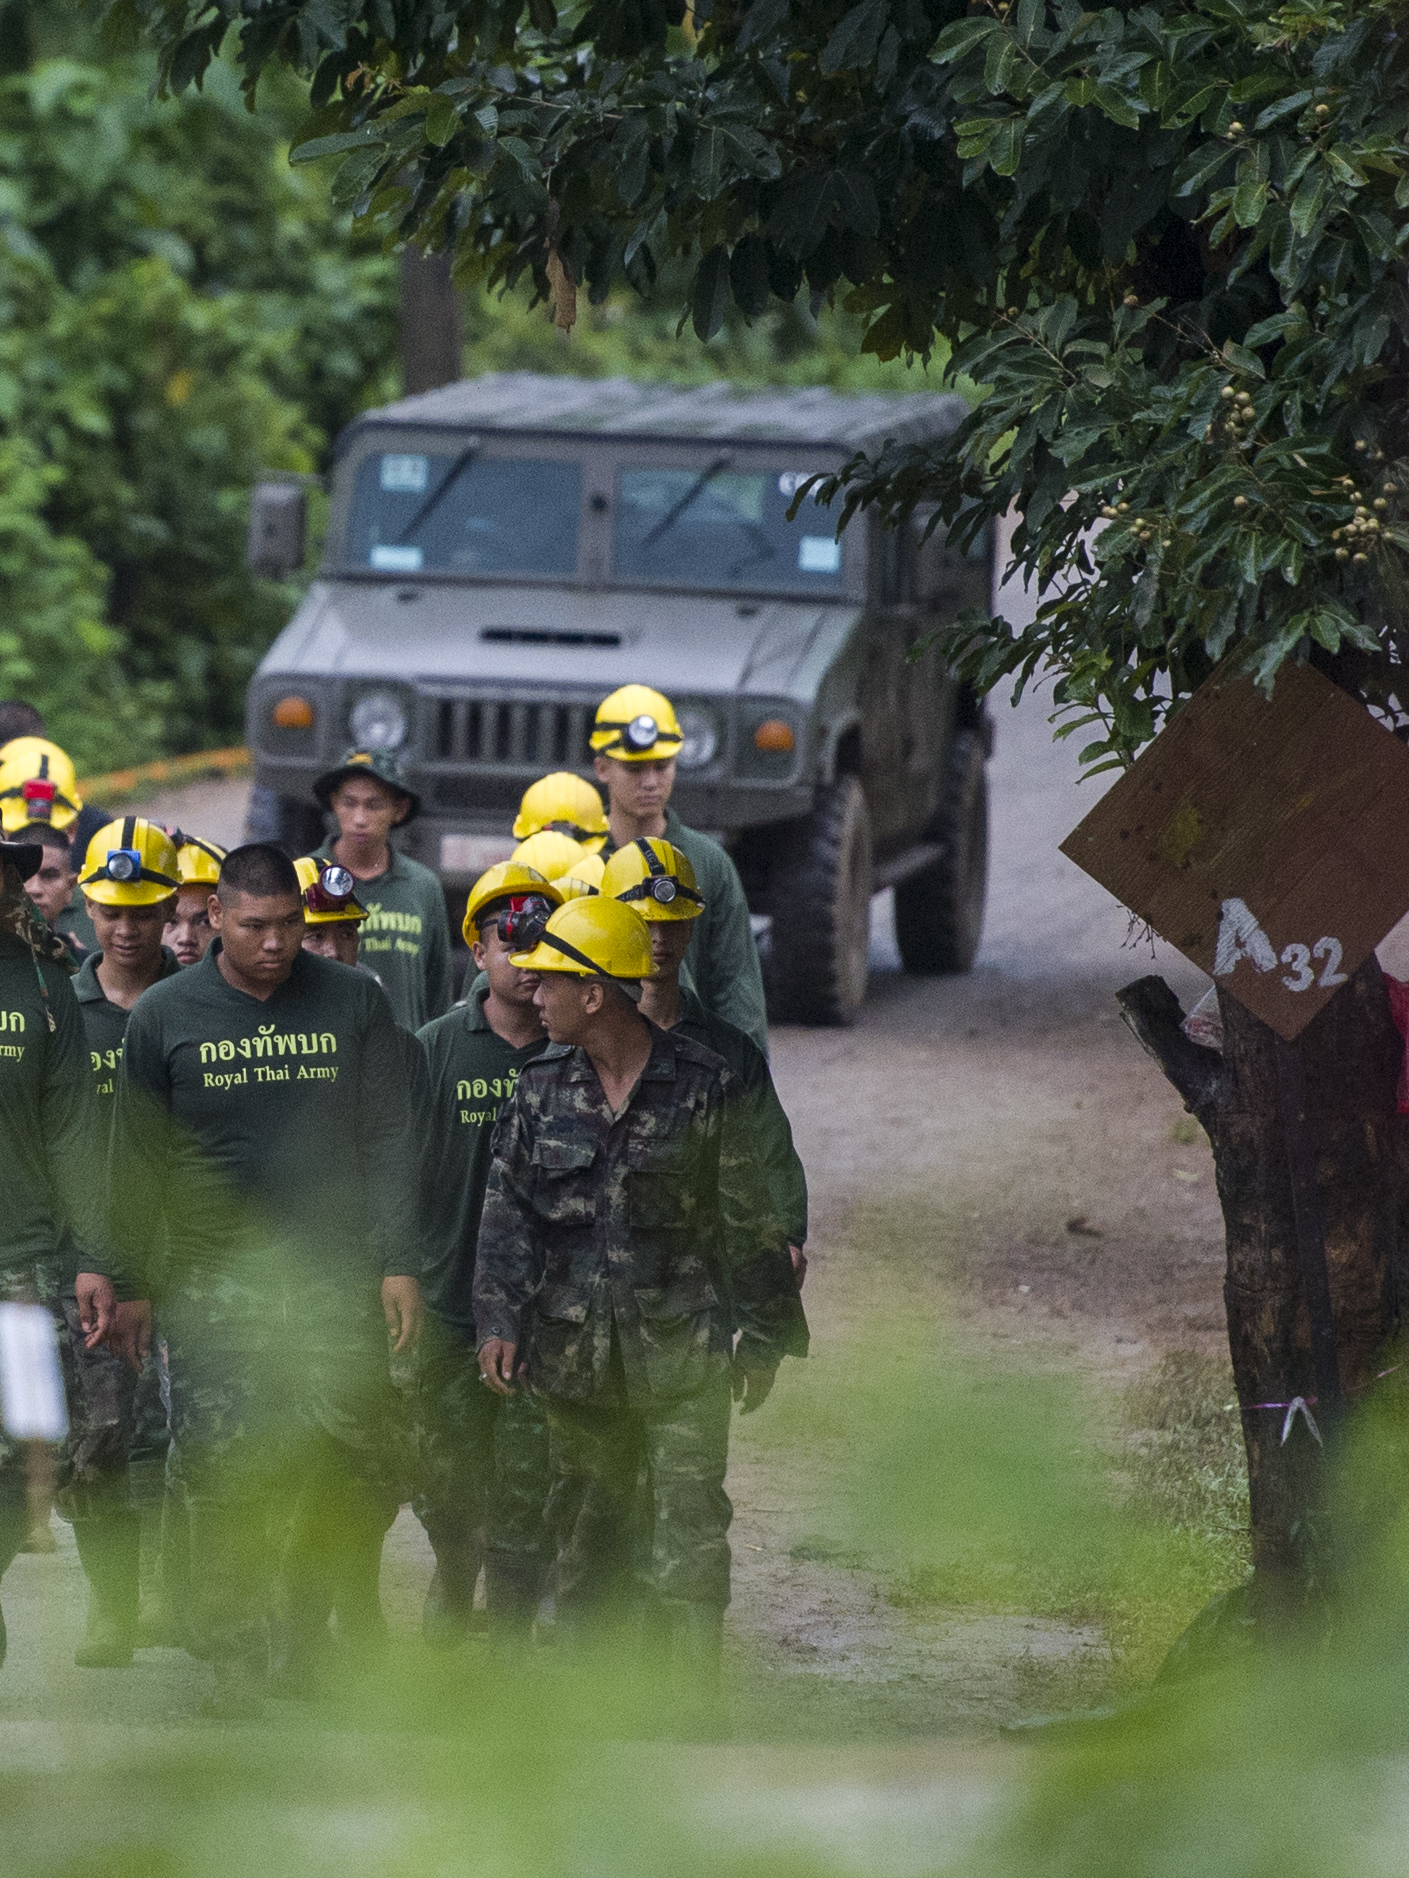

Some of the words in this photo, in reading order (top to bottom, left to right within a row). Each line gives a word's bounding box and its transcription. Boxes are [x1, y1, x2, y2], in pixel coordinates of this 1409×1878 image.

[199, 1024, 338, 1064] กองทัพบก
[203, 1067, 249, 1091] Royal
[254, 1064, 290, 1082] Thai
[296, 1065, 340, 1082] Army
[460, 1106, 497, 1127] Royal
